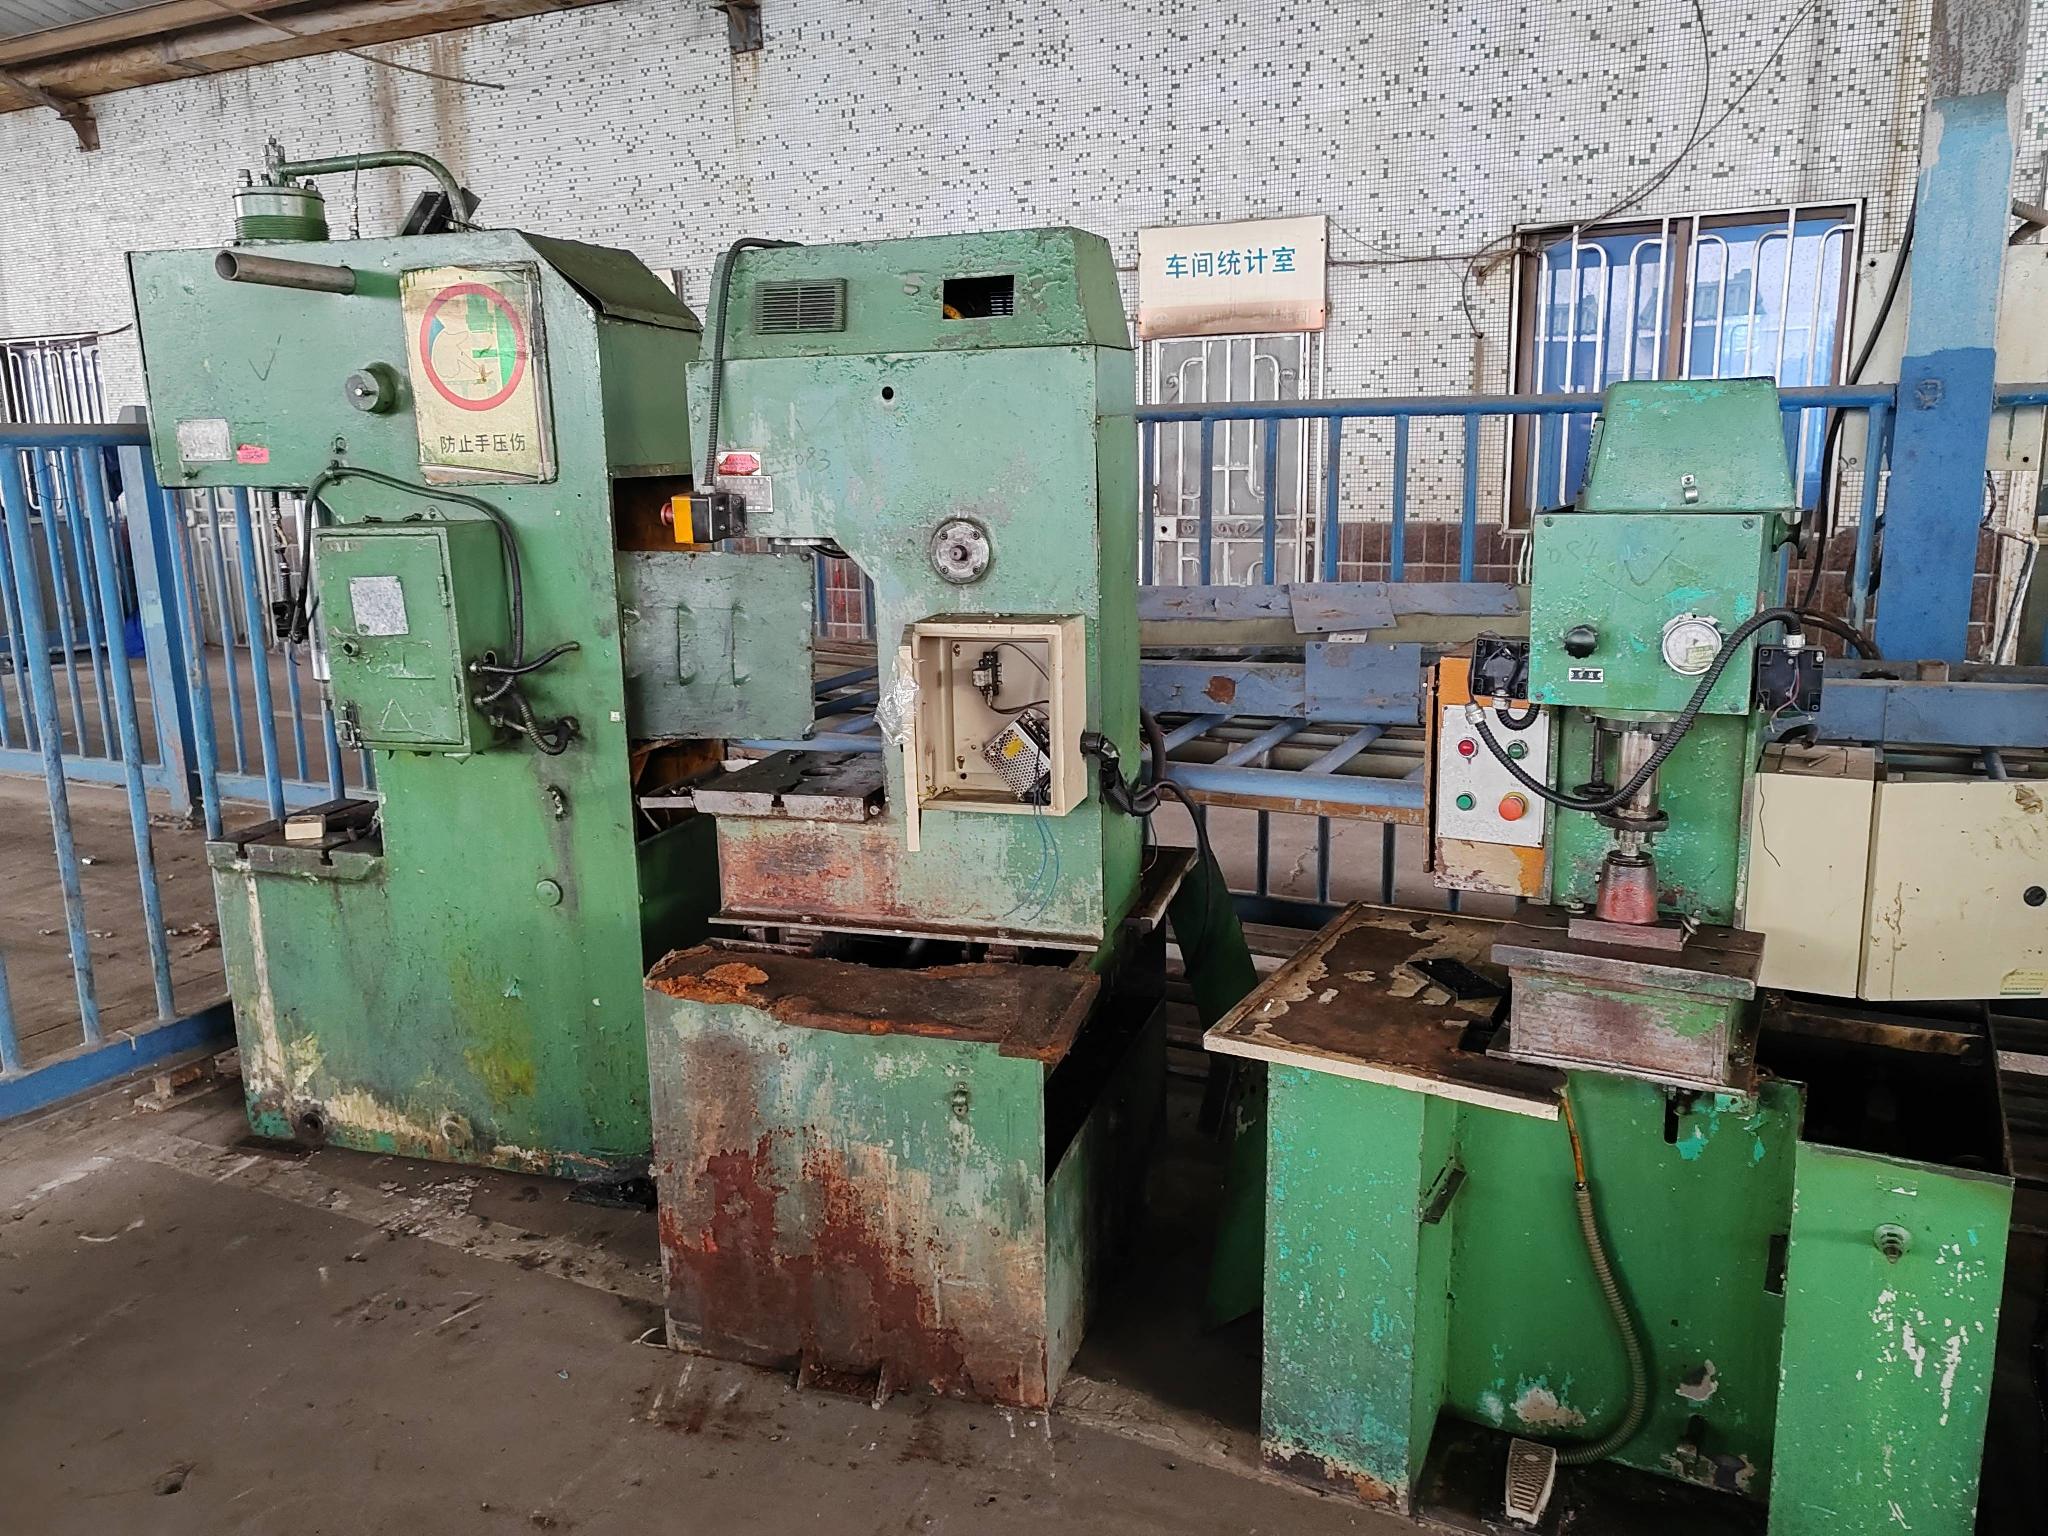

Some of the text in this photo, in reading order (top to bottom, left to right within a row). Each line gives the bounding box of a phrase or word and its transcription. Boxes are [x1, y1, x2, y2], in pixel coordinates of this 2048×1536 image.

[1165, 246, 1296, 279] 车间统计室
[440, 433, 526, 454] 防止手压伤
